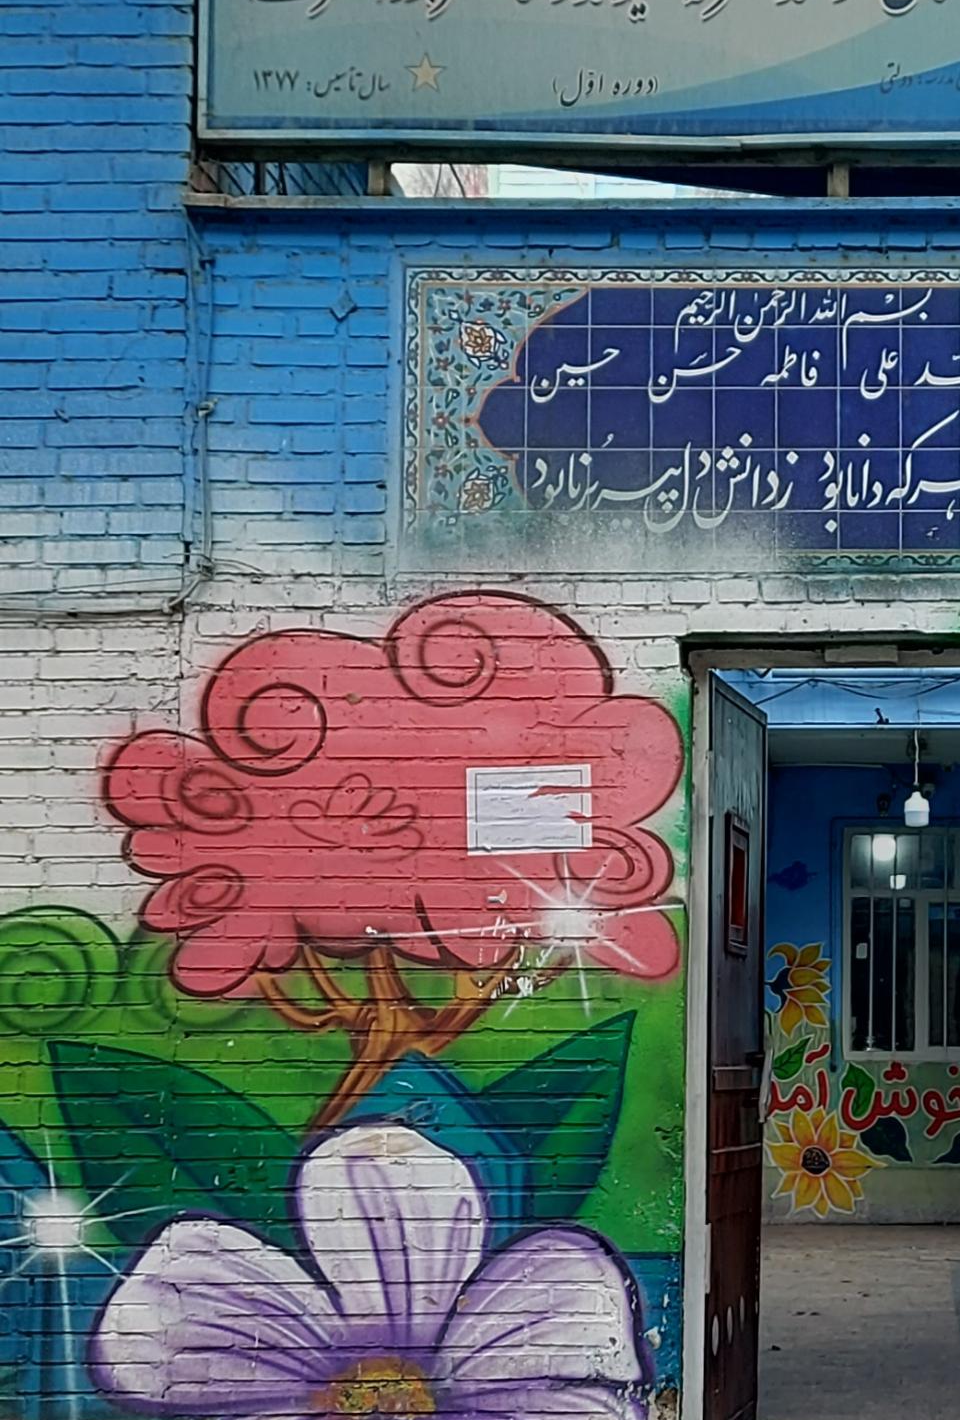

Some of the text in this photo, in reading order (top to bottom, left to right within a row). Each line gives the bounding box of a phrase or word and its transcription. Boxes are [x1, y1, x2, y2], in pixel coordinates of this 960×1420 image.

[253, 68, 300, 92] ۱۳۷۷
[358, 72, 391, 100] سال
[530, 347, 621, 403] حسین
[760, 345, 821, 386] فاطمه
[859, 348, 899, 399] علی
[591, 466, 682, 528] پیر
[644, 441, 711, 533] دل
[693, 433, 779, 529] دانش
[817, 451, 845, 533] بود
[847, 433, 883, 508] دانا
